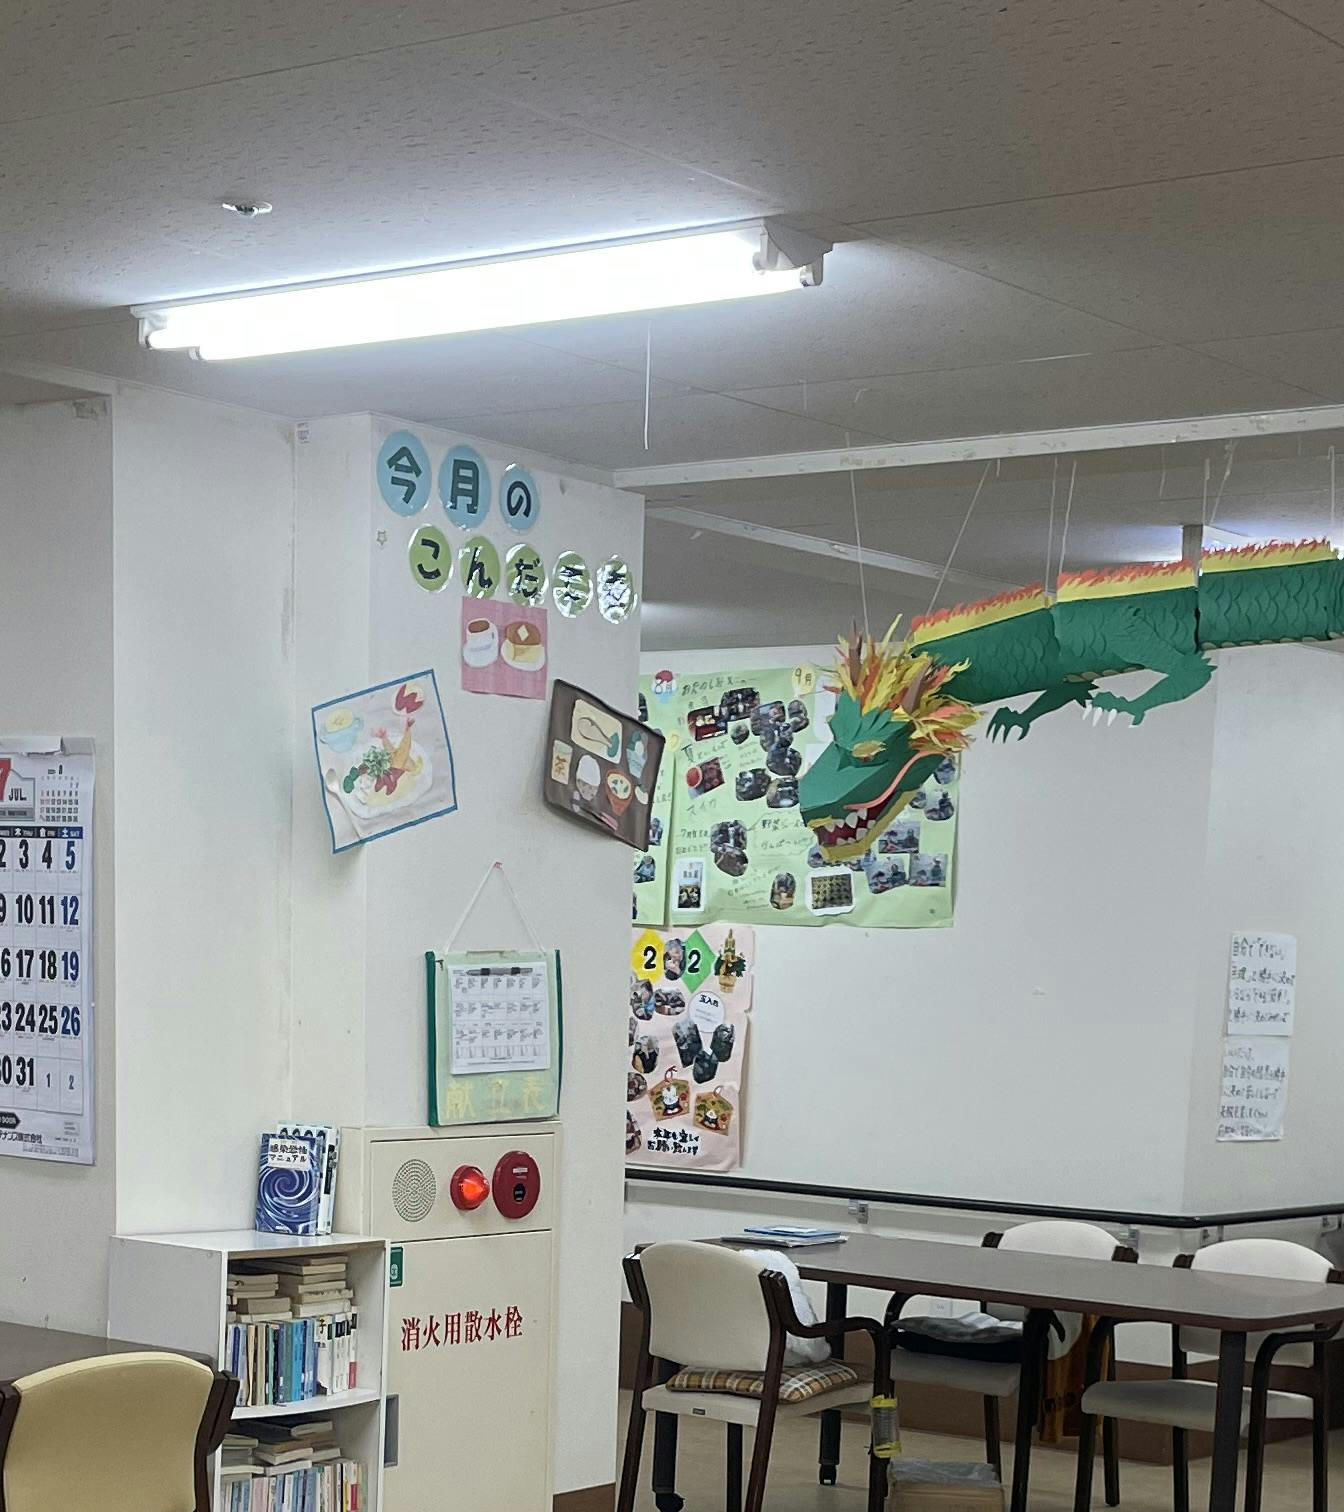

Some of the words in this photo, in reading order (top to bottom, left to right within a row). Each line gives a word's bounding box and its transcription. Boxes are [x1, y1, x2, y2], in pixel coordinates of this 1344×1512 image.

[386, 446, 532, 518] 今月の
[19, 839, 29, 869] 3
[42, 840, 52, 869] 4
[66, 841, 75, 870] 5
[16, 894, 33, 924] 10
[39, 895, 54, 924] 11
[61, 895, 79, 925] 12
[16, 949, 34, 978] 17
[39, 950, 57, 980] 18
[61, 951, 79, 981] 19
[644, 945, 657, 970] 2
[688, 949, 701, 973] 2
[15, 1002, 35, 1032] 24
[39, 1004, 58, 1034] 25
[61, 1005, 80, 1036] 26
[16, 1056, 34, 1086] 31
[46, 1073, 51, 1087] 1
[68, 1075, 74, 1090] 2
[401, 1305, 523, 1352] 消火用散水栓
